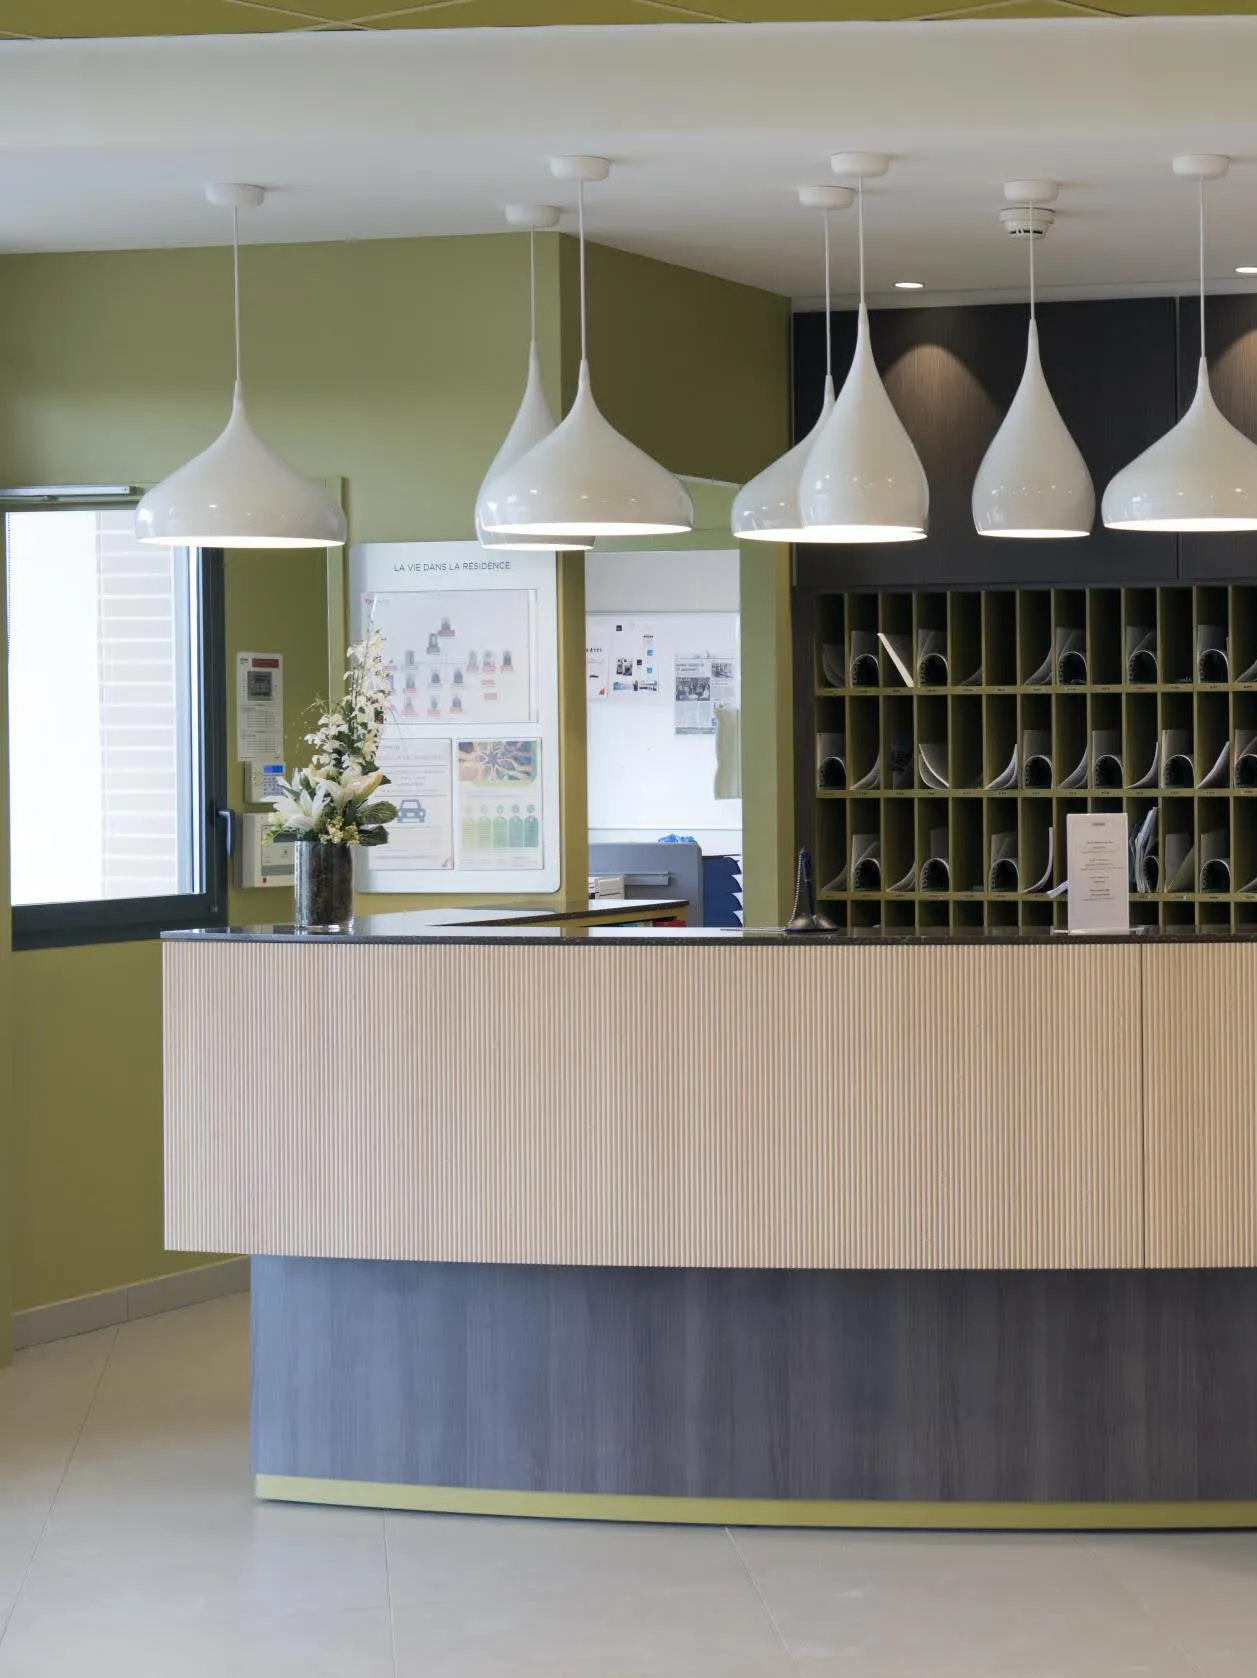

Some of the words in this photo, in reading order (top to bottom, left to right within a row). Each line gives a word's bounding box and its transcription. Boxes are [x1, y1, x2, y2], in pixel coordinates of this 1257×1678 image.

[393, 563, 405, 572] LA
[407, 563, 421, 572] VIE
[423, 563, 447, 571] DANS
[449, 562, 460, 571] LA
